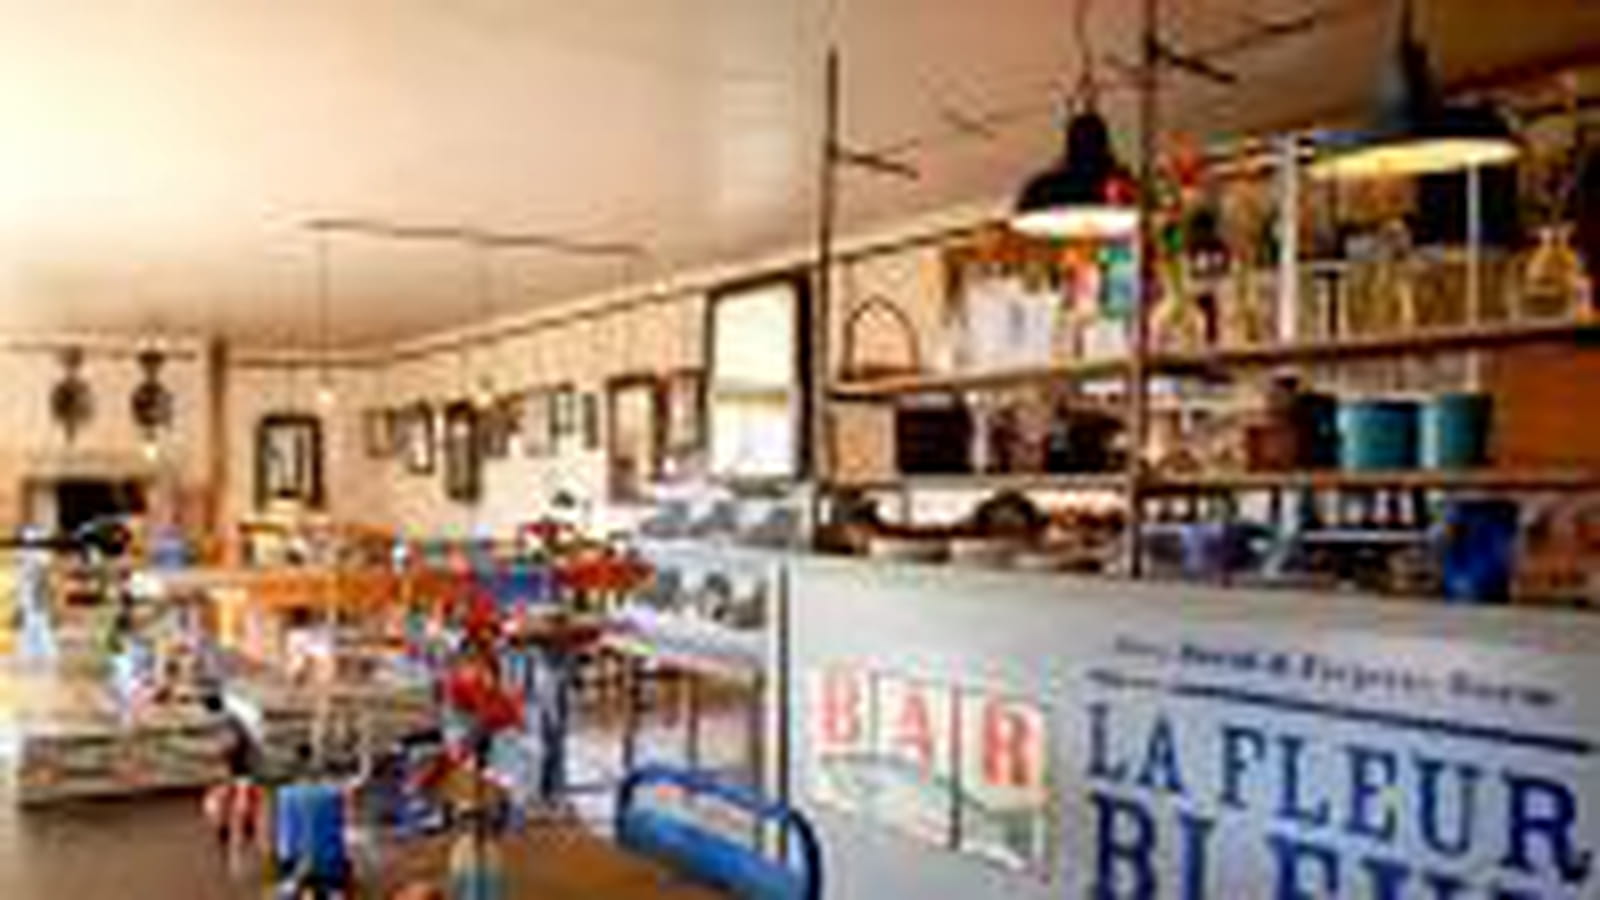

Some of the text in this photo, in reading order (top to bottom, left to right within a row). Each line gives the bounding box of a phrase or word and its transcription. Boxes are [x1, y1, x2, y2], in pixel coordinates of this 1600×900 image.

[821, 668, 1029, 788] BAR
[1085, 701, 1592, 884] LA FLEUR
[1088, 791, 1544, 900] BLE
